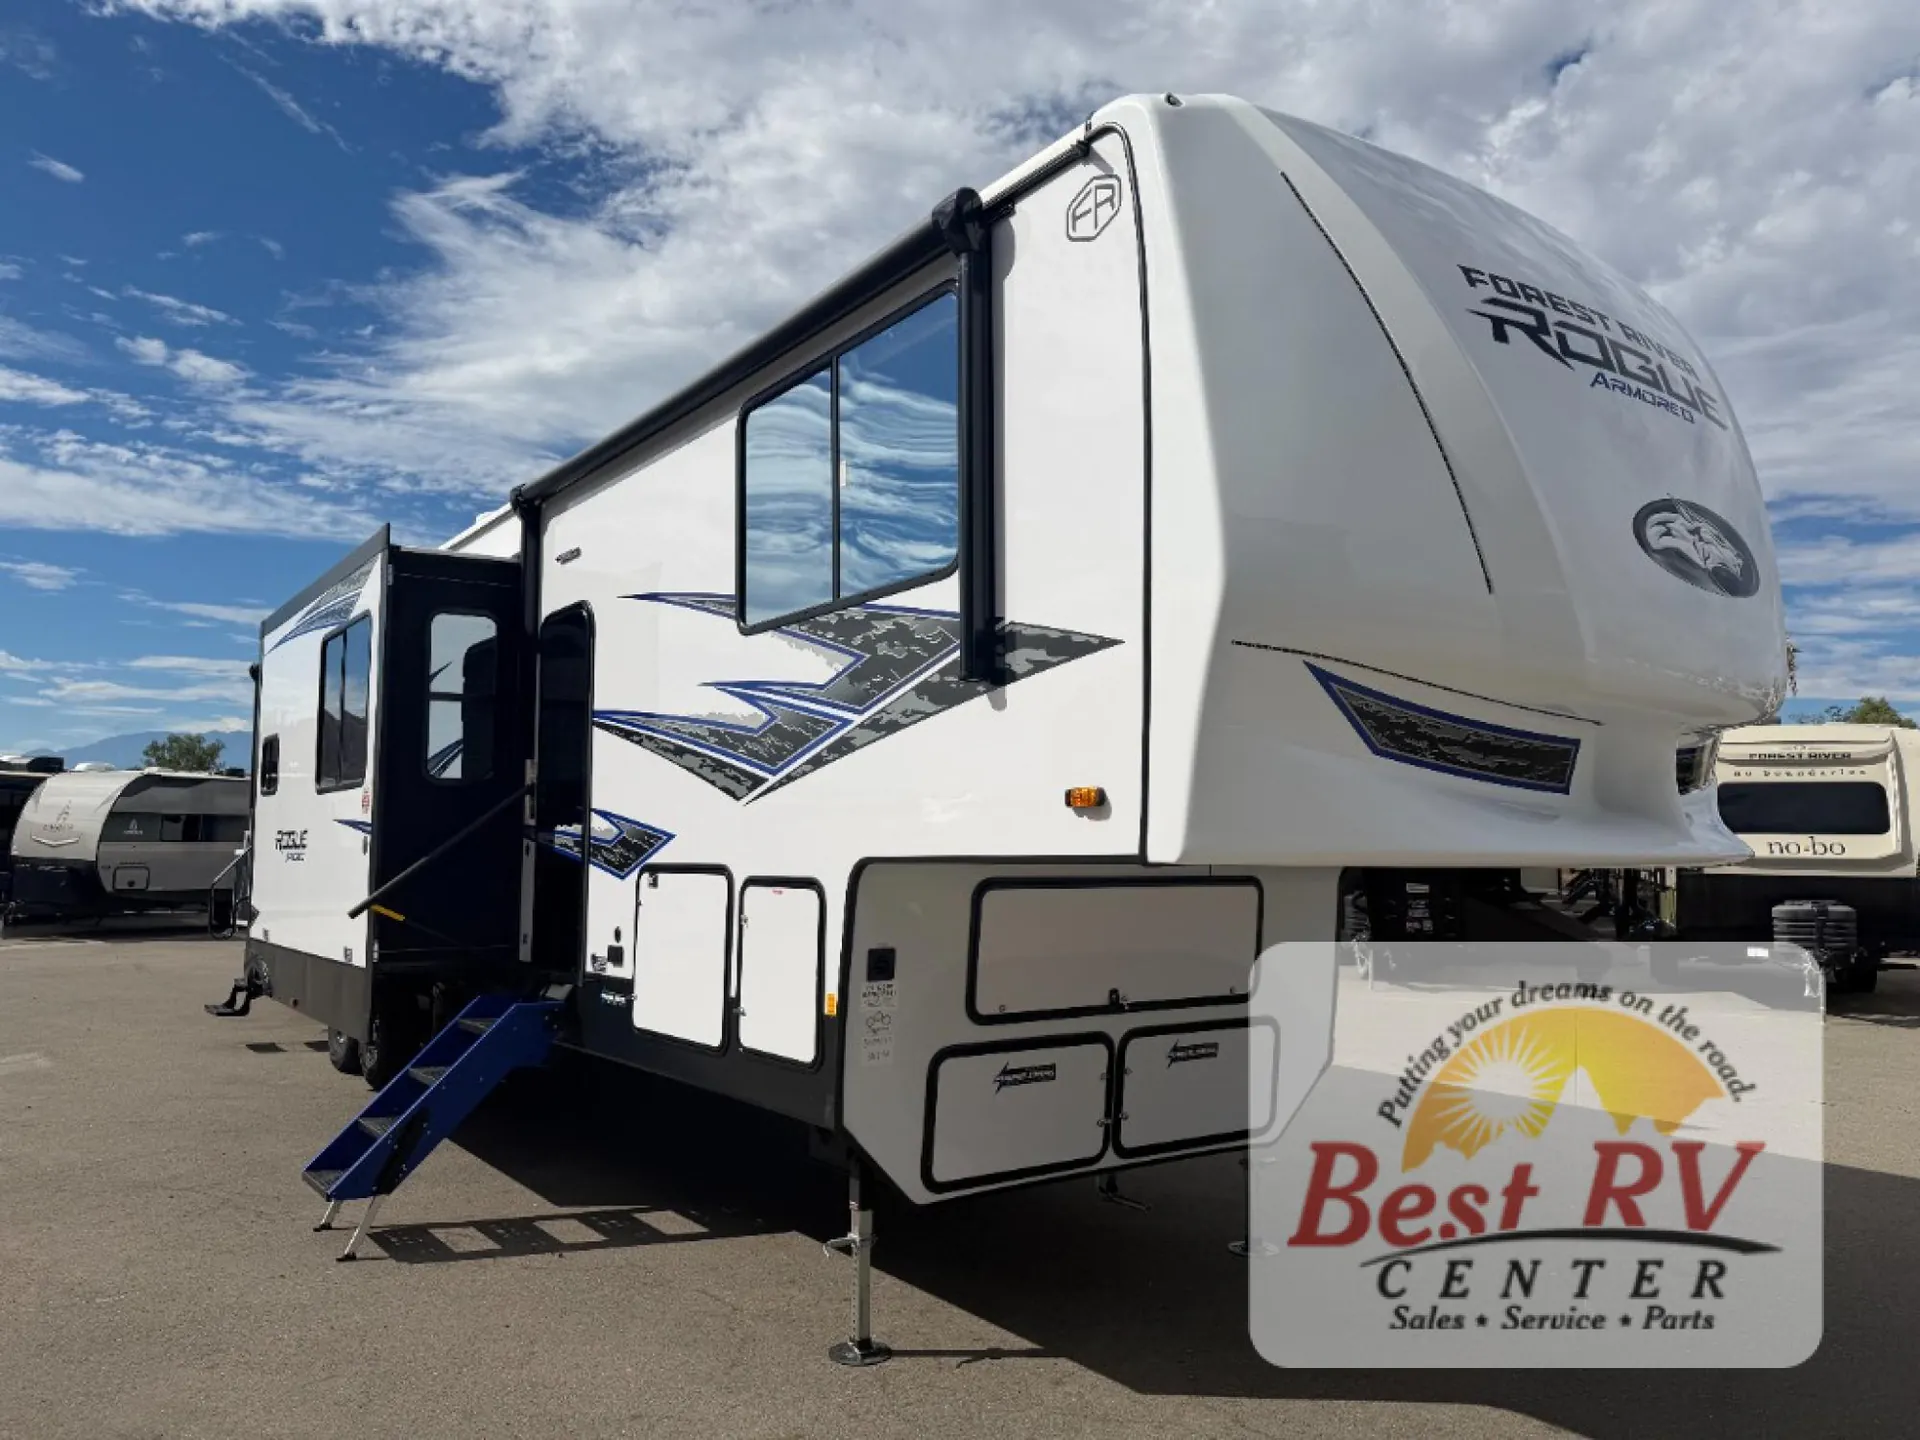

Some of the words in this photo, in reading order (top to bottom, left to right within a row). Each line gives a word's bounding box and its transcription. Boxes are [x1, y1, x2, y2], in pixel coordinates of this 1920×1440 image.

[1457, 264, 1611, 332] FOREST
[1465, 297, 1728, 431] ROGUE
[1590, 371, 1696, 425] ARMORED
[1748, 751, 1803, 760] FOREST
[1807, 751, 1852, 760] RIVER
